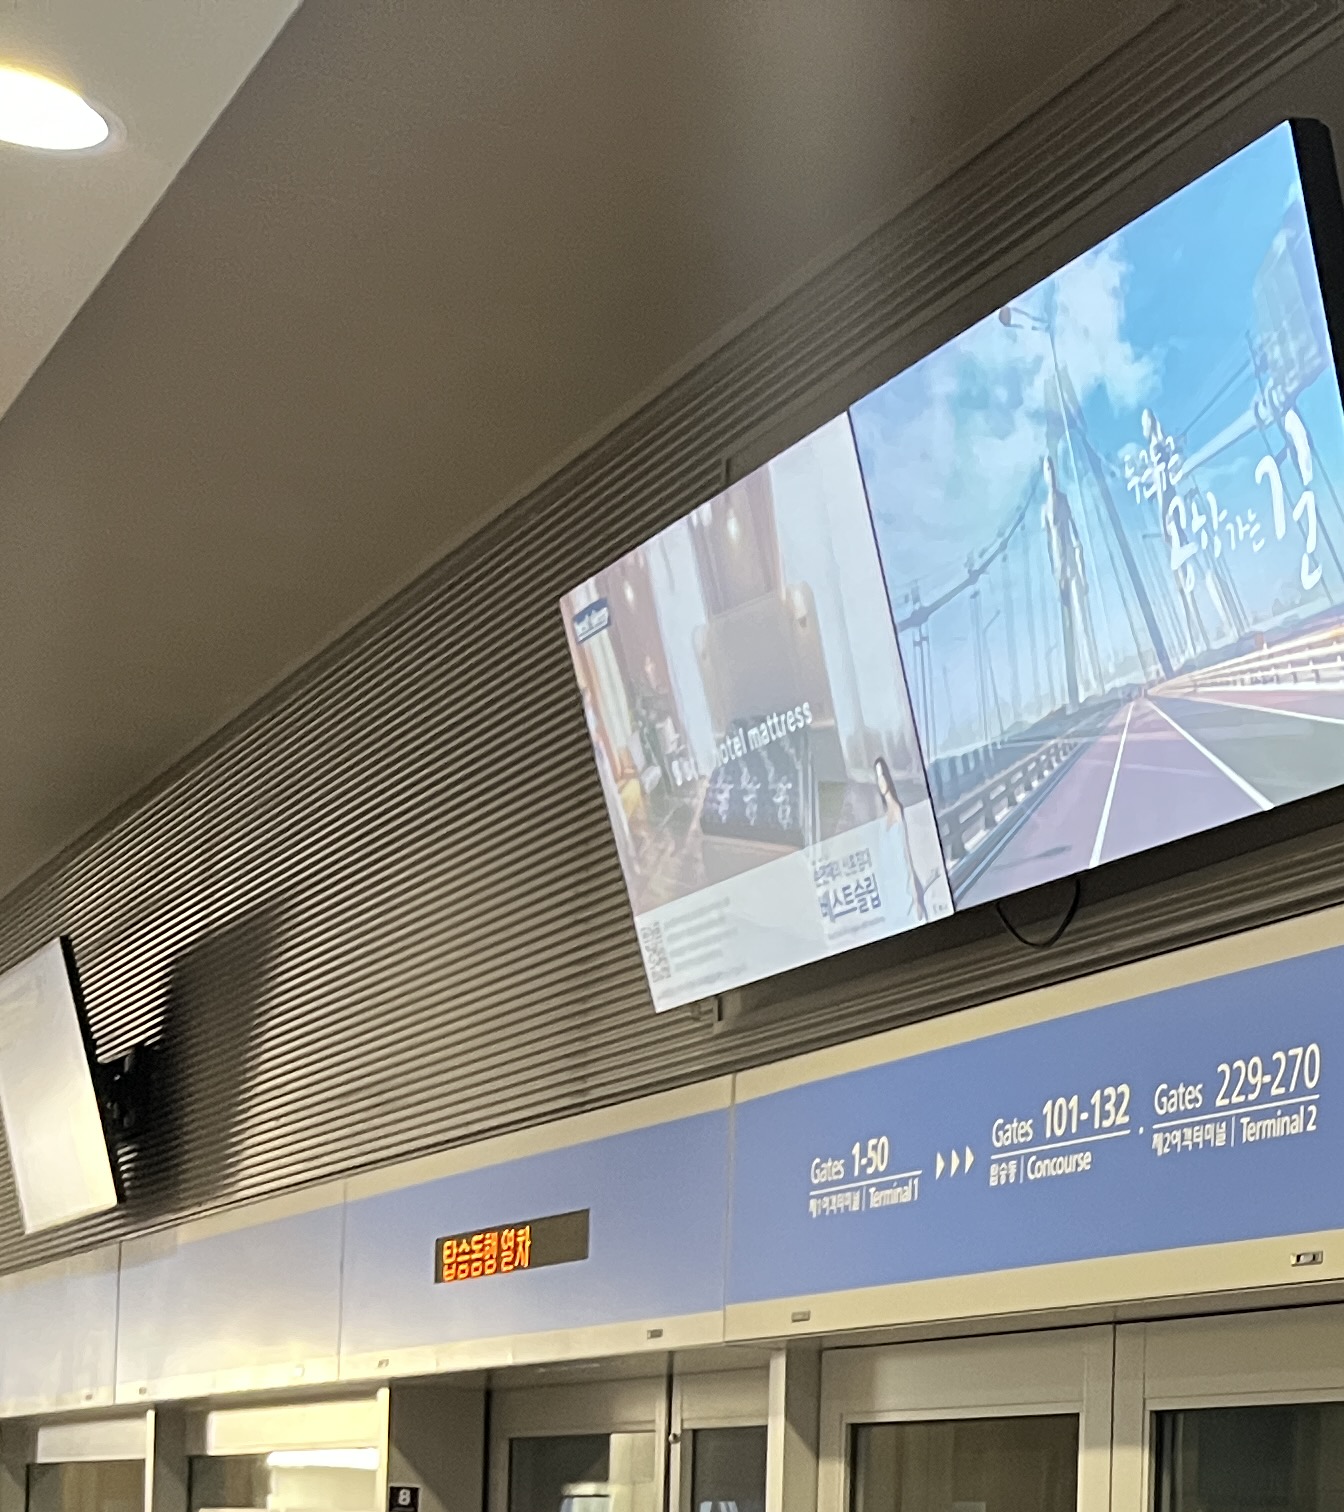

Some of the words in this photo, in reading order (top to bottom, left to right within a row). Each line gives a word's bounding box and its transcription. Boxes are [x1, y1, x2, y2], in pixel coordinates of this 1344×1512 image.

[1254, 409, 1322, 591] 길
[748, 701, 813, 751] mattress
[1154, 1082, 1203, 1116] Gates
[1215, 1042, 1321, 1108] 229-270
[992, 1117, 1034, 1148] Gates
[1042, 1083, 1131, 1139] 101-132
[1240, 1105, 1305, 1145] Terminal
[1306, 1104, 1318, 1133] 2
[810, 1157, 845, 1184] Gates
[851, 1135, 890, 1178] 1-50
[1027, 1151, 1092, 1181] Concourse
[868, 1176, 913, 1209] Terminal
[913, 1176, 920, 1201] 1
[442, 1231, 499, 1283] 탑승동행
[500, 1224, 532, 1273] 열차
[398, 1488, 411, 1506] 8
